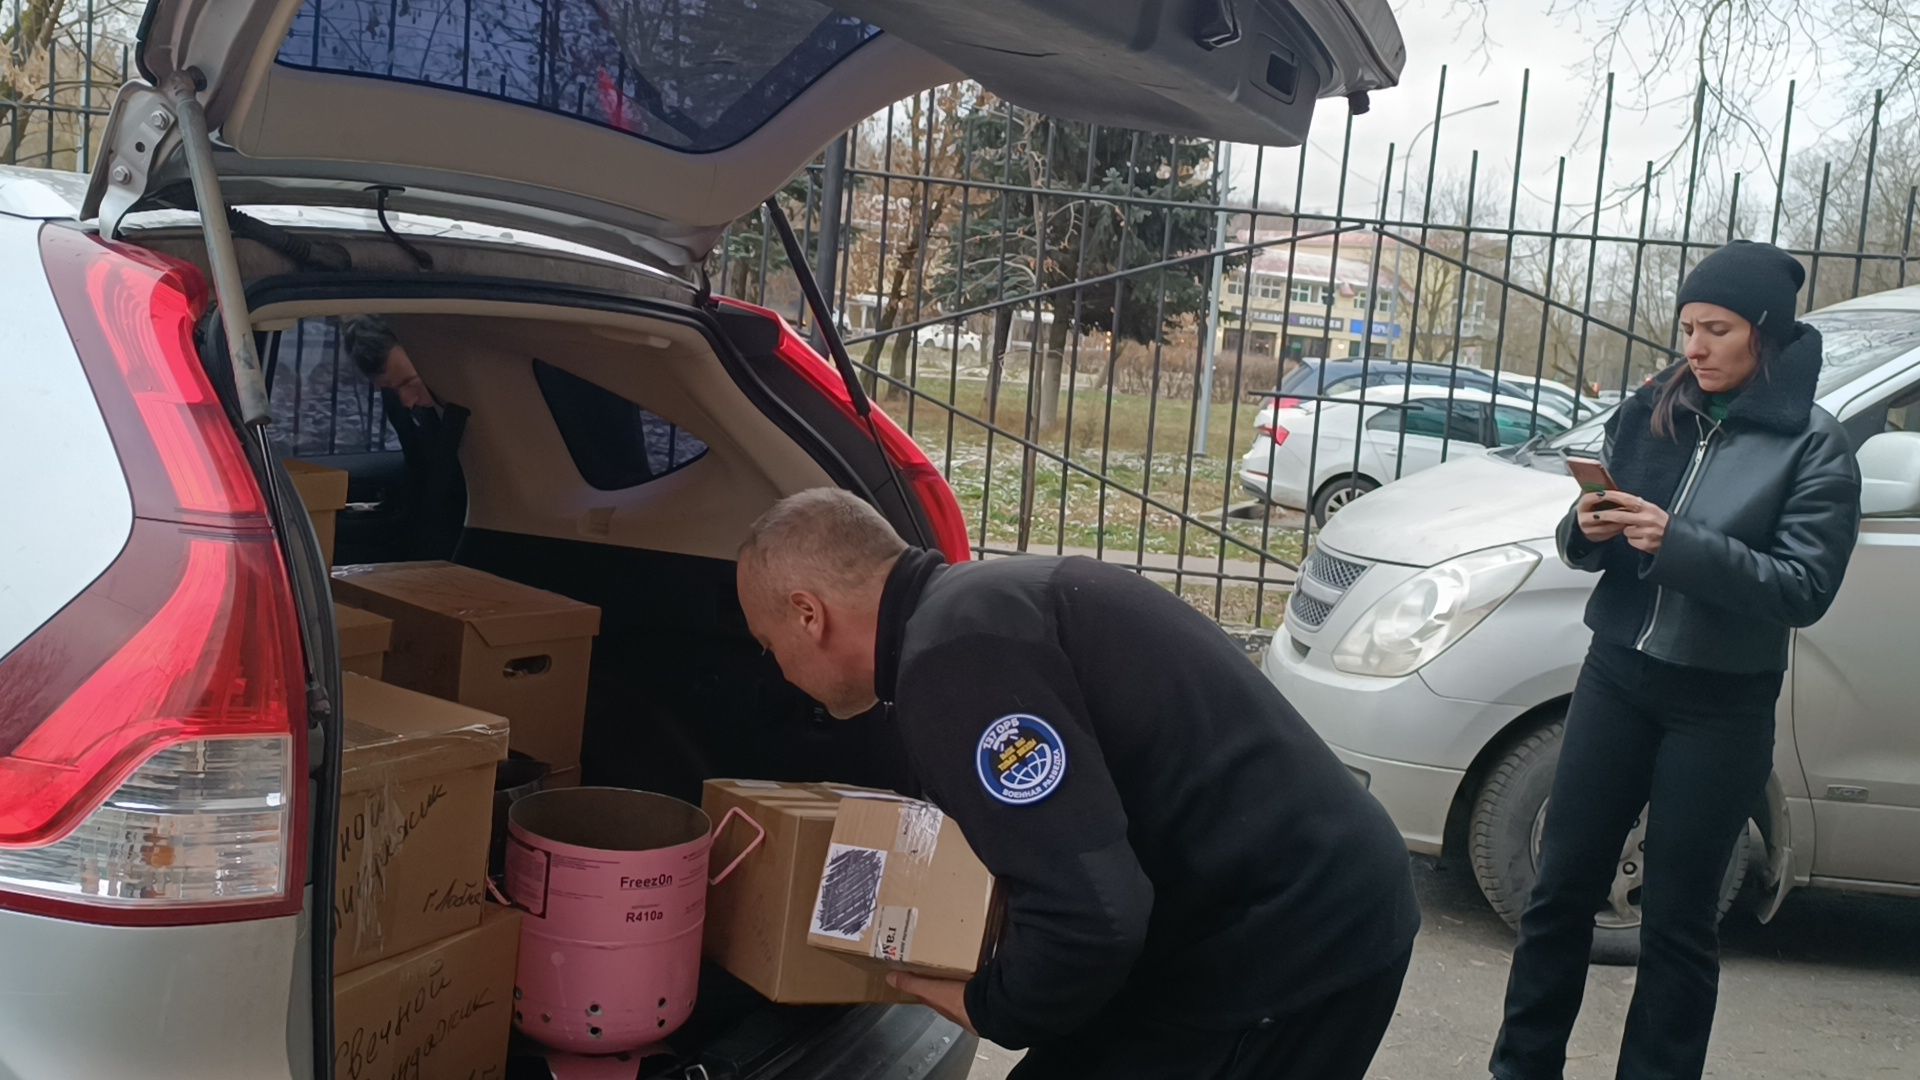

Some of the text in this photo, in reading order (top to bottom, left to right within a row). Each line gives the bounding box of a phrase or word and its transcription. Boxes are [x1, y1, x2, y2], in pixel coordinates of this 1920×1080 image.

[983, 717, 1020, 749] 137 ОРБ
[1002, 787, 1042, 798] ВОЕННАЯ
[1042, 748, 1062, 789] РАЗВЕДКА
[625, 910, 663, 923] R410a
